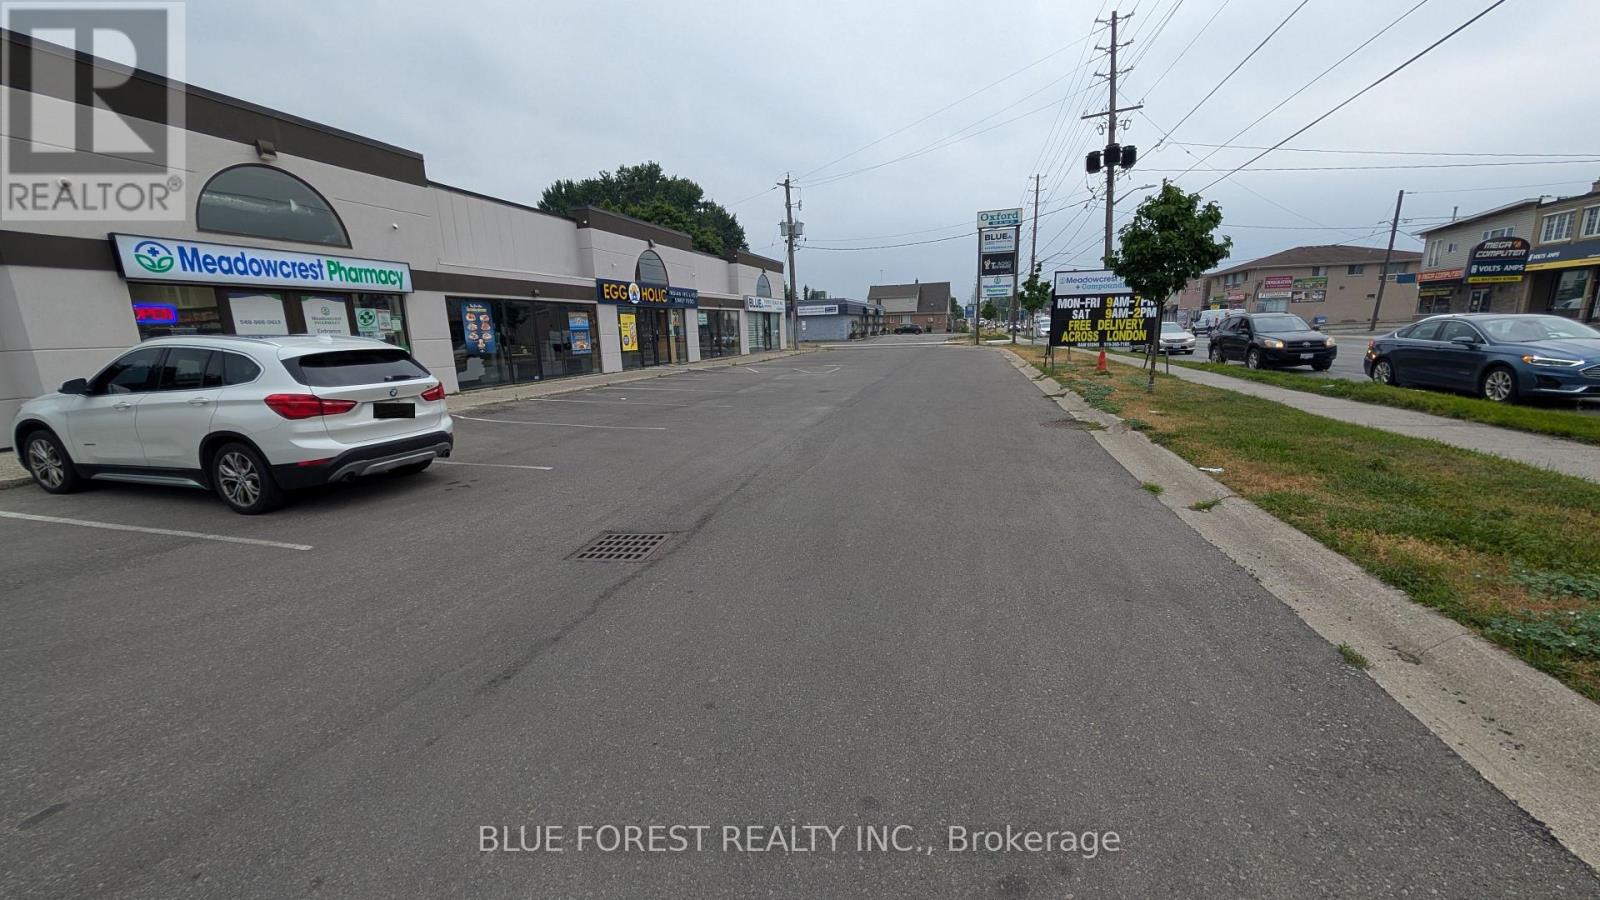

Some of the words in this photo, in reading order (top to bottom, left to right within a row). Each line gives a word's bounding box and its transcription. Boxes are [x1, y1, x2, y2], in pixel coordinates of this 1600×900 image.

[980, 210, 1018, 221] Oxford
[984, 233, 1008, 241] BLUE
[1484, 240, 1513, 249] MEGA
[1475, 249, 1526, 258] COMPUTER
[177, 245, 324, 281] Meadowcrest
[327, 260, 404, 289] Pharmacy
[1479, 264, 1501, 272] VOLTS
[1503, 264, 1524, 272] AMPS
[1066, 274, 1118, 284] Meadowcrest
[1081, 282, 1127, 290] Compoundi
[603, 283, 628, 300] EGG
[641, 287, 668, 303] HOLIC
[1057, 296, 1101, 309] MON-FRI
[1072, 309, 1091, 320] SAT
[1105, 307, 1157, 319] 9AM-2PM
[1068, 320, 1092, 331] FREE
[1097, 318, 1145, 331] DELIVERY
[1061, 331, 1100, 342] ACROSS
[1106, 329, 1147, 341] LONDON
